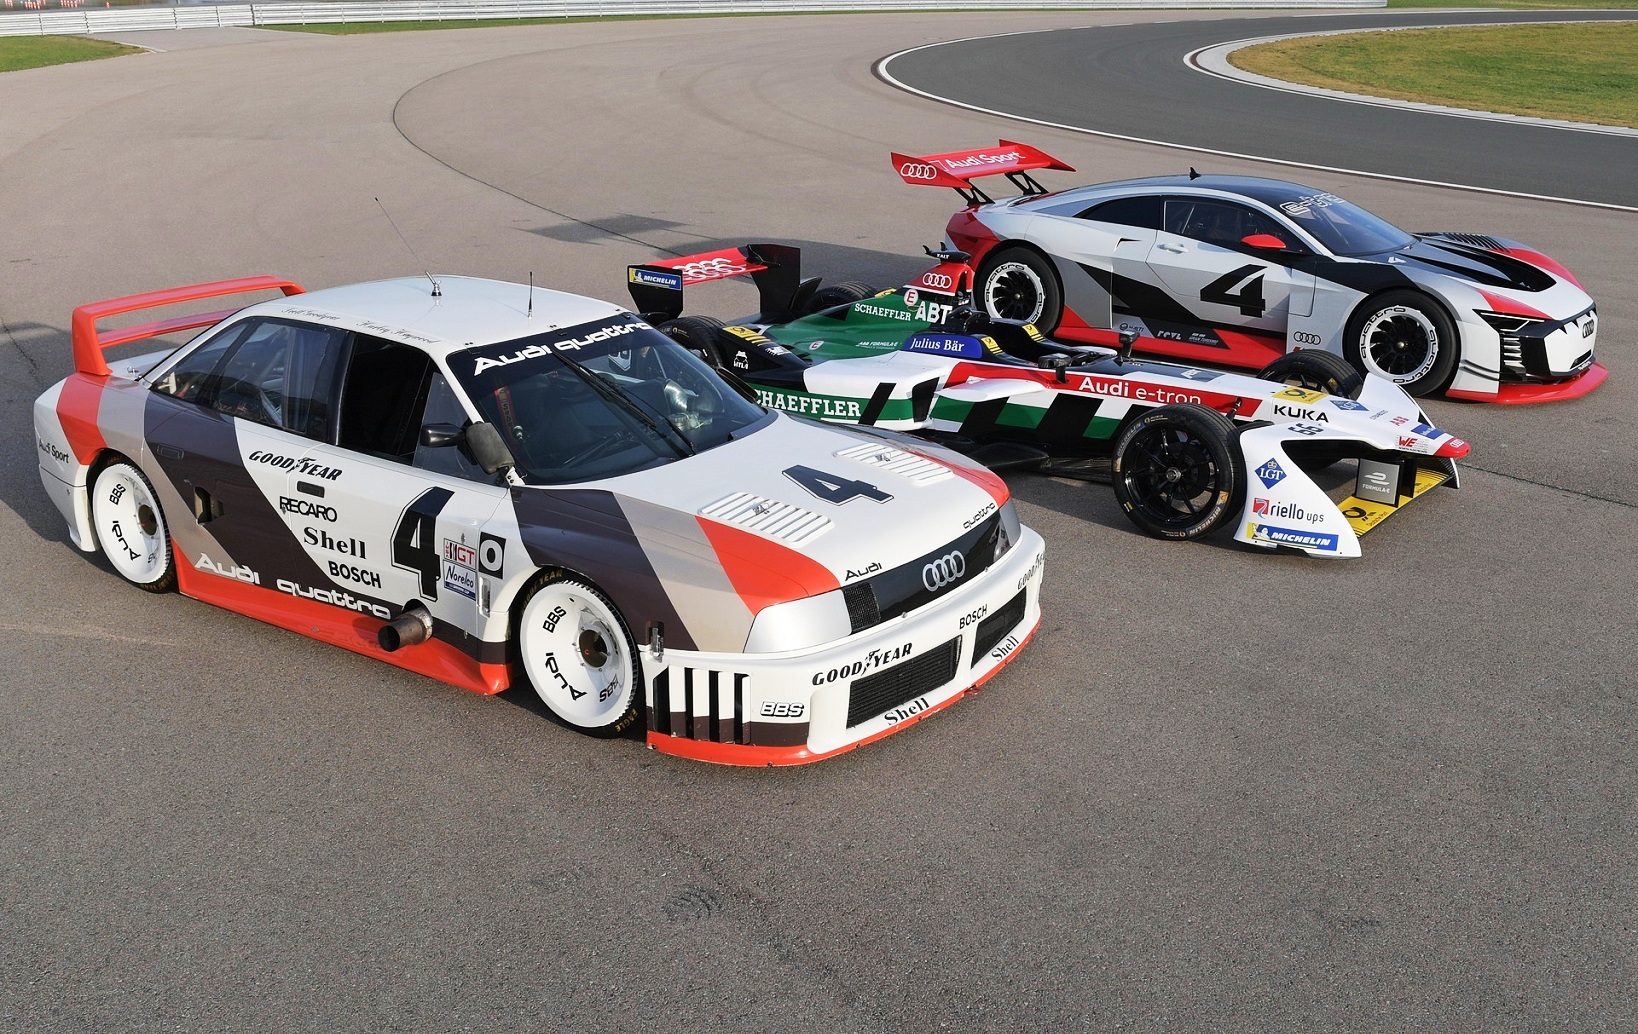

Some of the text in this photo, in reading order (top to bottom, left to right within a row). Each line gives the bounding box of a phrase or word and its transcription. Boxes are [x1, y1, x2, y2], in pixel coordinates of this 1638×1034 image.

[945, 150, 1026, 170] Audi Sport
[643, 274, 677, 286] MICHELIN
[986, 264, 1025, 303] quattro
[1200, 264, 1268, 319] 4
[854, 302, 912, 321] SCHAEFFLER
[914, 300, 952, 325] ABT
[910, 338, 965, 352] Julius Bär
[1361, 307, 1406, 359] quattro
[474, 322, 654, 376] Audi quattro
[1393, 330, 1437, 383] quattro
[755, 388, 862, 418] CHAEFFLER
[1078, 376, 1201, 404] Audi e-tron
[1274, 404, 1329, 423] KUKA
[39, 438, 69, 464] Audi Sport
[1397, 435, 1418, 448] WE
[782, 464, 894, 506] 4
[1259, 468, 1284, 481] LGT
[109, 483, 126, 505] BBS
[279, 495, 338, 522] RECARO
[963, 501, 996, 530] quattro
[1190, 505, 1222, 535] MICHELIN
[1270, 502, 1325, 524] riello ups
[111, 520, 142, 561] Audi
[303, 526, 366, 560] Shell
[390, 485, 455, 602] 4
[1271, 531, 1331, 547] MICHELIN
[457, 546, 475, 565] GT
[328, 560, 382, 589] BOSCH
[445, 565, 474, 588] Norelco
[845, 562, 883, 582] Audi
[195, 552, 260, 585] Audi
[276, 578, 391, 621] quattro
[542, 605, 567, 634] BBS
[959, 604, 988, 630] BOSCH
[991, 635, 1020, 663] Shell
[545, 652, 588, 702] Audi
[614, 708, 638, 733] EAGLE
[760, 701, 805, 718] BBS
[884, 697, 930, 726] Shell
